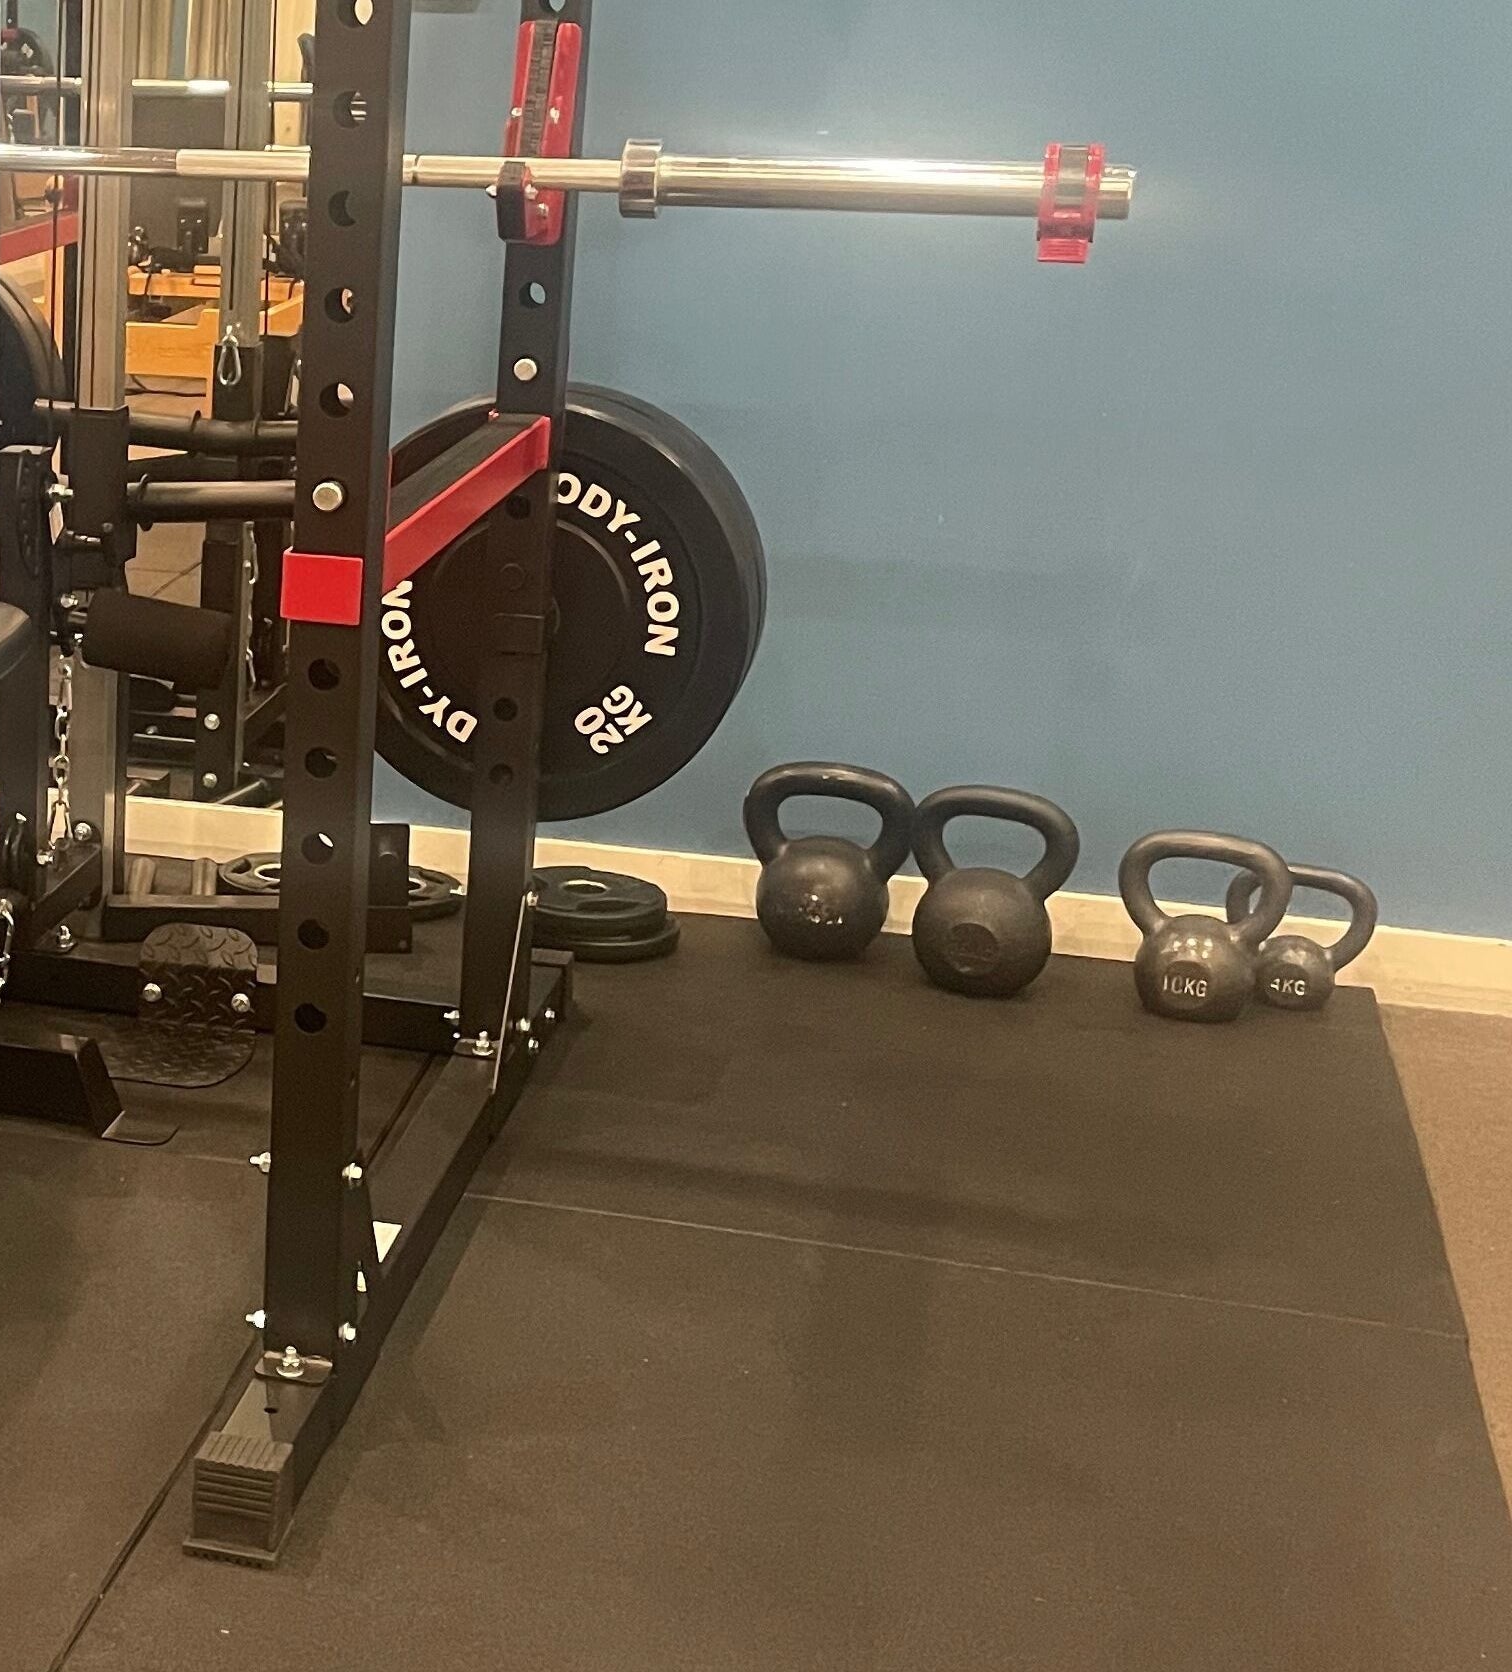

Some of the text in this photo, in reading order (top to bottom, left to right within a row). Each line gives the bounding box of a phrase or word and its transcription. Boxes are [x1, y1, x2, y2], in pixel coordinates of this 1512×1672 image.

[557, 472, 680, 657] ODY-IRON
[381, 580, 478, 743] DY-IRON
[574, 706, 625, 754] 20
[602, 685, 653, 736] KG
[1162, 974, 1209, 998] 10KG
